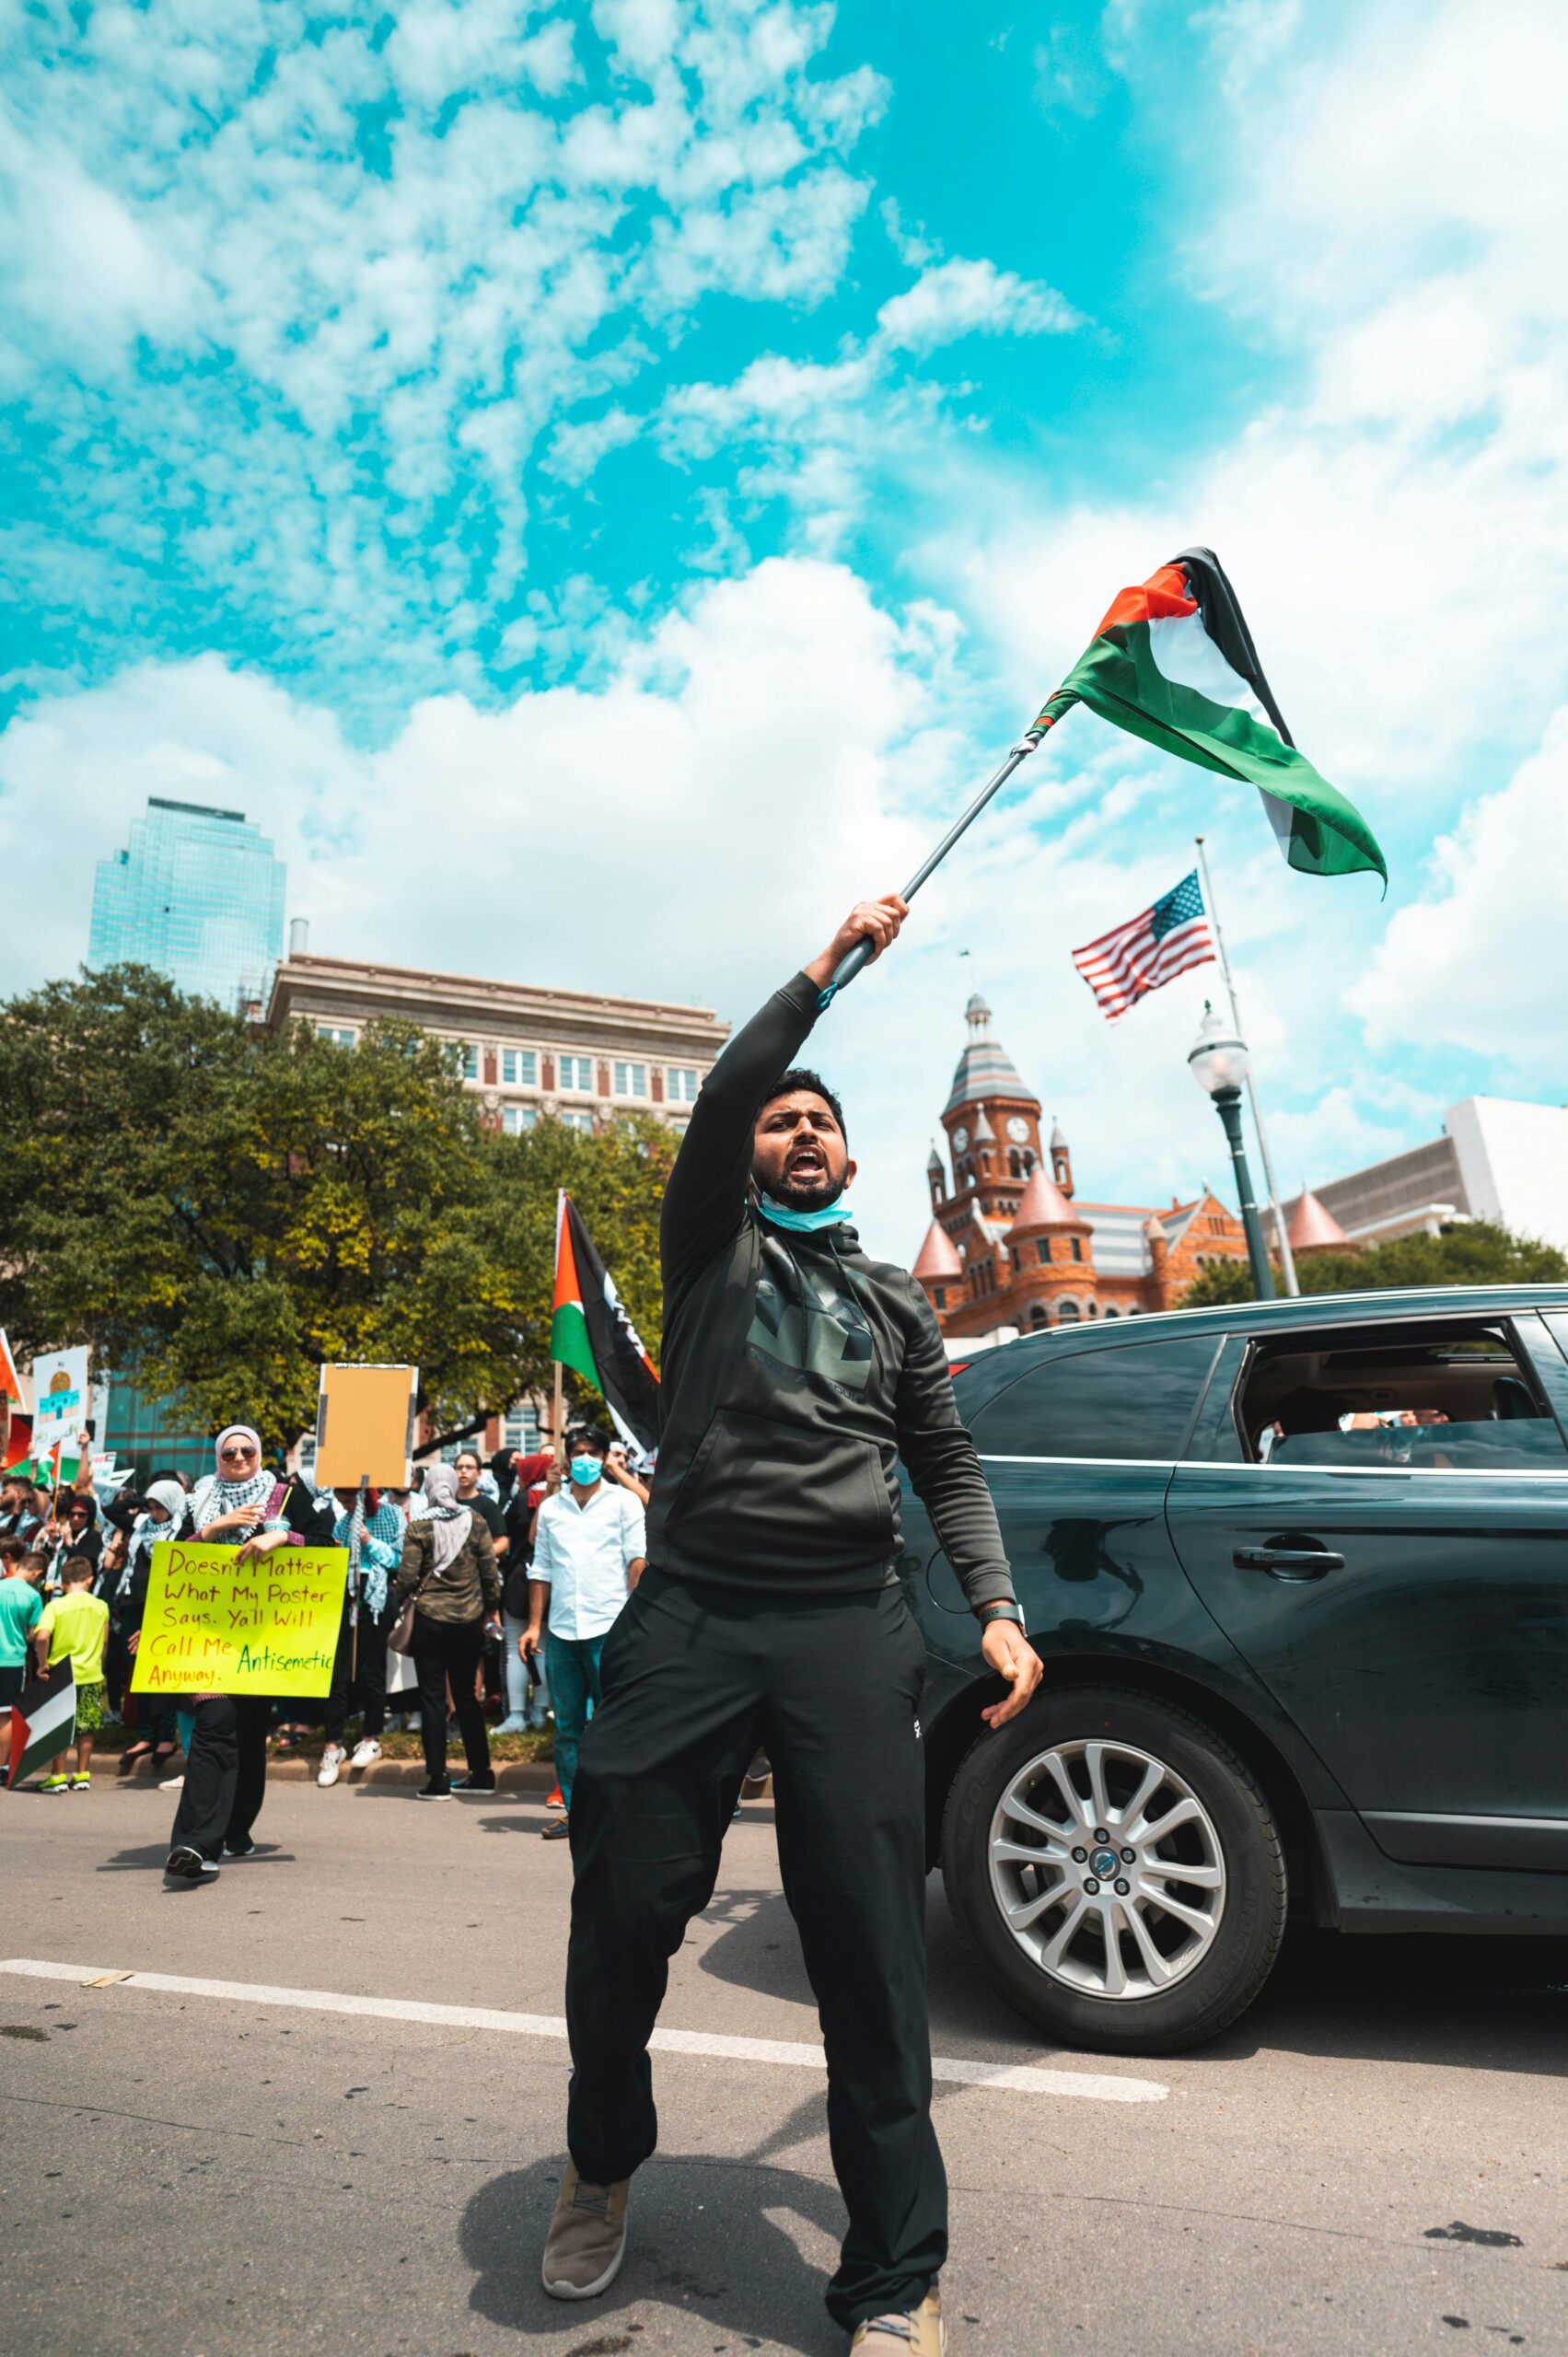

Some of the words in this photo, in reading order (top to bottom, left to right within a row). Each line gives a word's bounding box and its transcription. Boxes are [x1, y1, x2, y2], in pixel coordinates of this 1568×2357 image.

[251, 1555, 331, 1577] Matter
[165, 1583, 221, 1603] What
[232, 1586, 259, 1610] My
[268, 1585, 331, 1604] Poster
[162, 1607, 217, 1634] Says.
[274, 1610, 314, 1627] Will
[150, 1634, 192, 1657] Call
[203, 1638, 232, 1657] Me
[237, 1644, 333, 1675] Antisemetic
[148, 1665, 222, 1689] Anyway.
